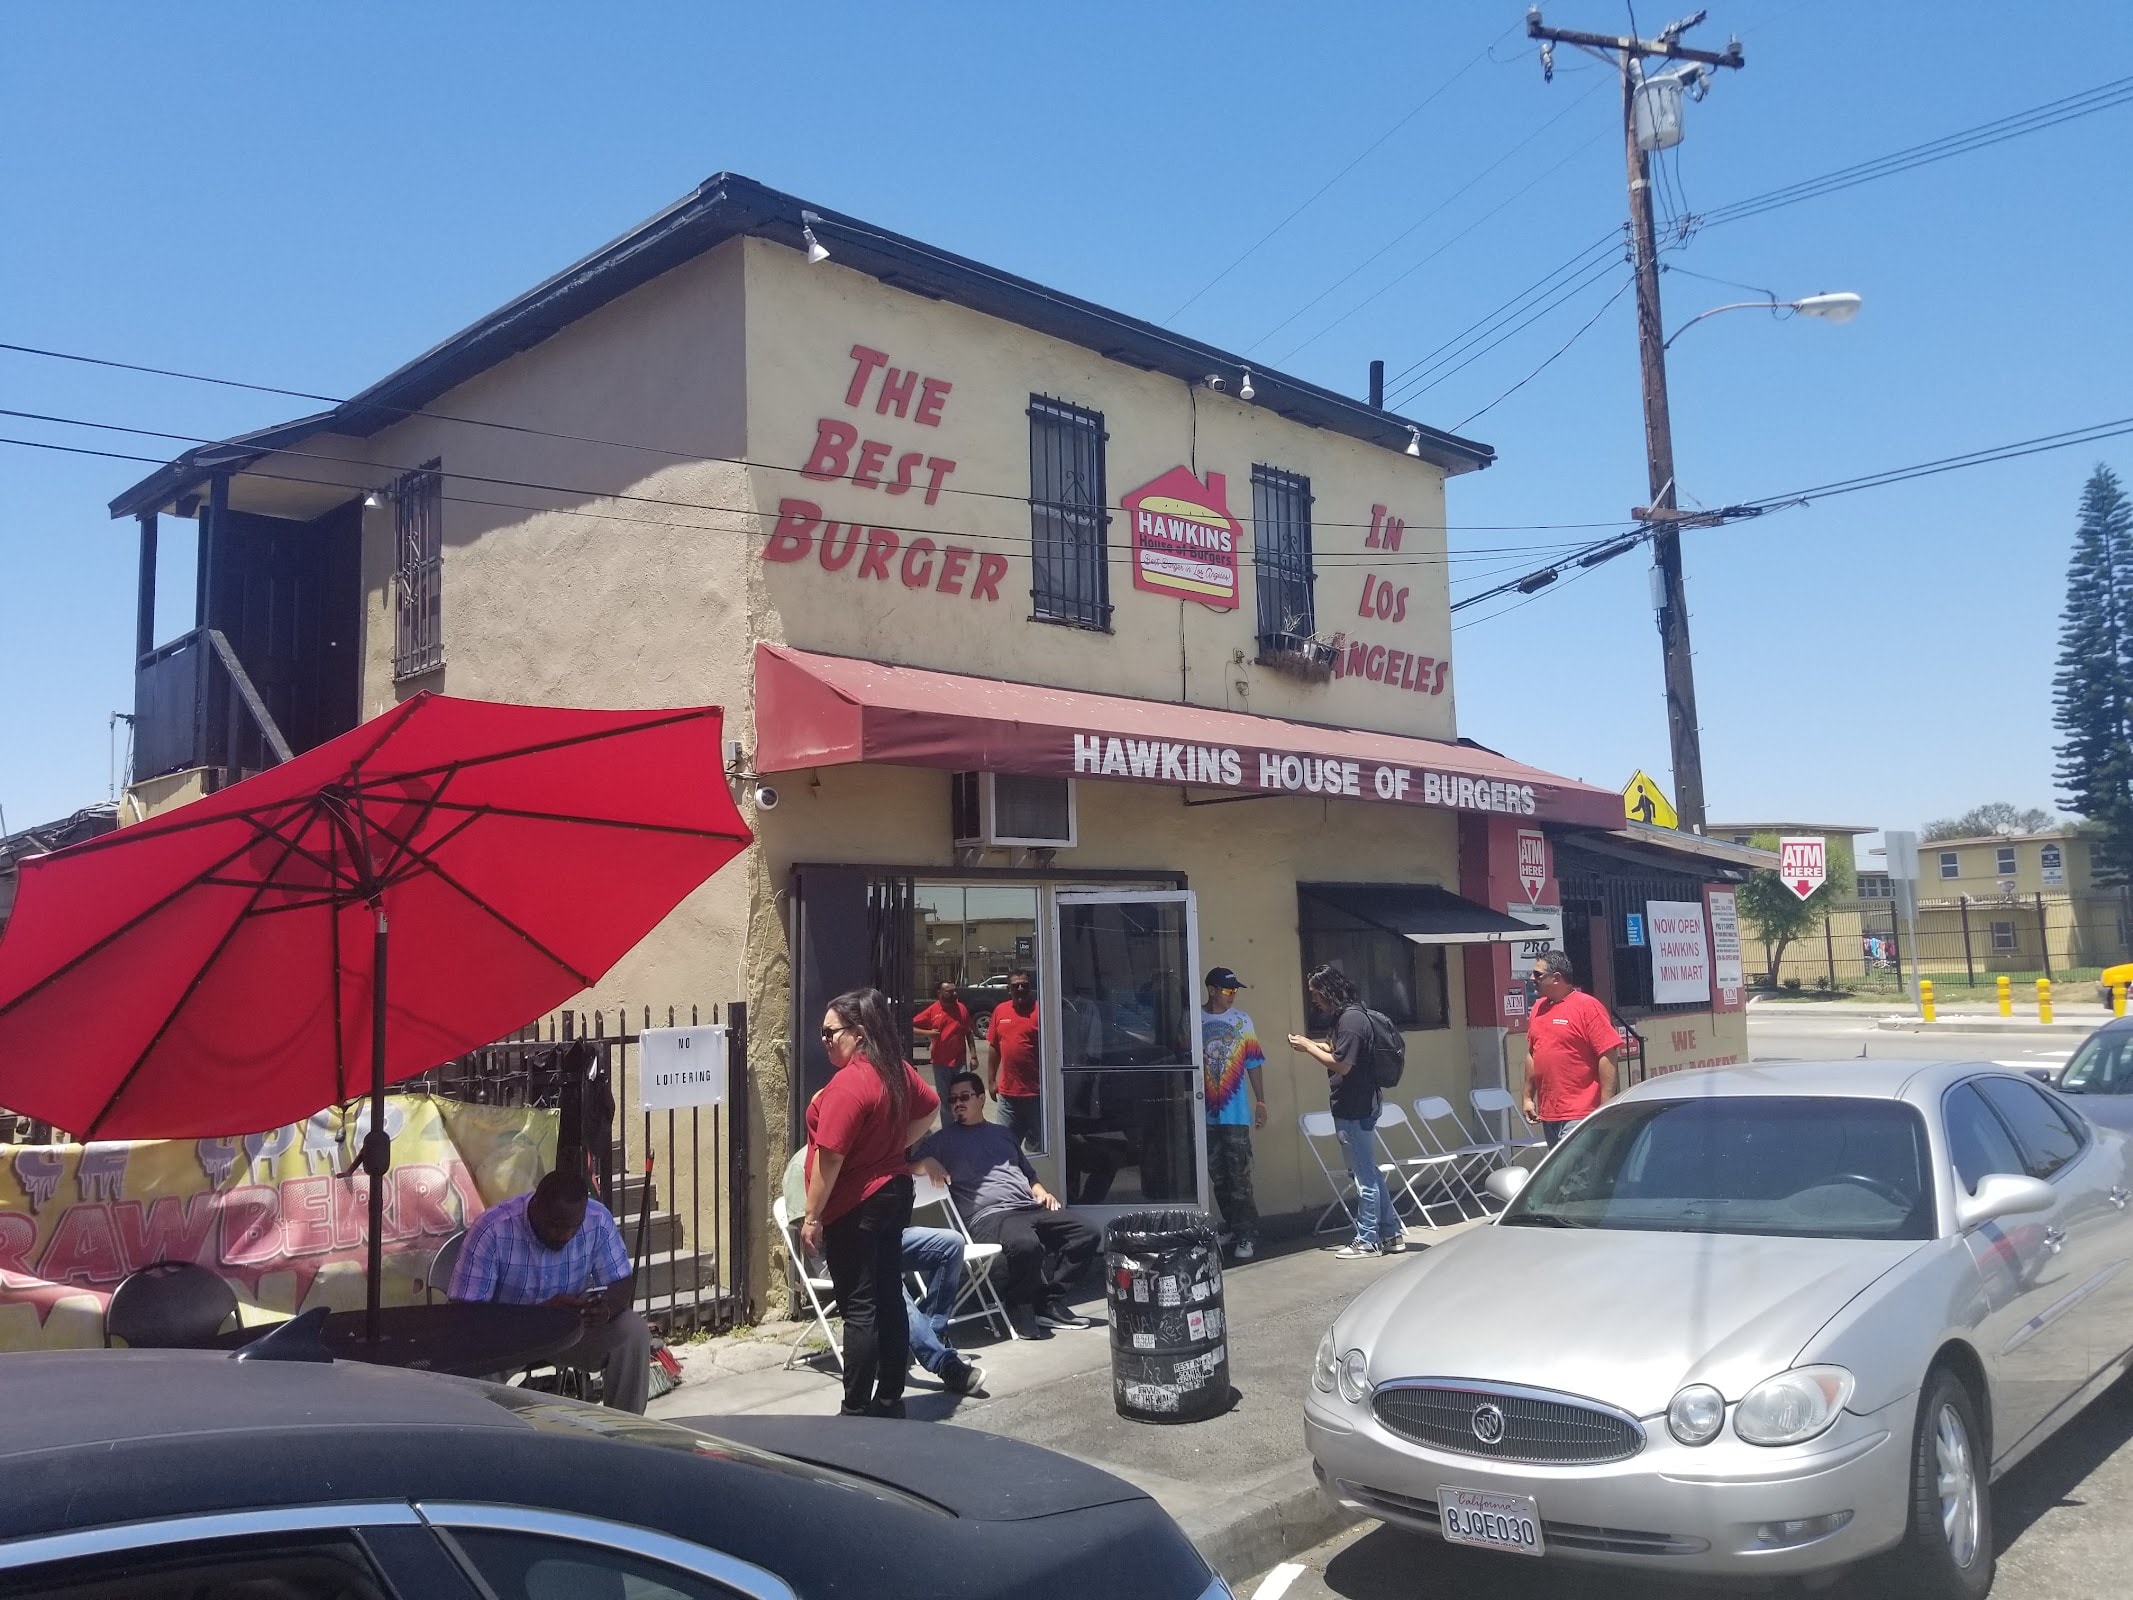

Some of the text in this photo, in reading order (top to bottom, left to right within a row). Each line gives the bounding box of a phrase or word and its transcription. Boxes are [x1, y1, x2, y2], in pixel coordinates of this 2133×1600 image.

[845, 344, 952, 427] THE
[801, 419, 956, 505] BEST
[1139, 511, 1231, 552] HAWKINS
[1365, 504, 1405, 551] IN
[761, 499, 1008, 601] BURGER
[1140, 533, 1173, 551] House
[1190, 546, 1232, 566] Burgers
[1359, 574, 1409, 622] LOS
[1074, 734, 1535, 815] HAWKINS HOUSE OF BURGERS
[1521, 839, 1543, 865] ATM
[1783, 845, 1822, 867] ATM
[1522, 865, 1543, 876] HERE
[1784, 867, 1822, 877] HERE
[1654, 919, 1675, 933] NOW
[1678, 919, 1700, 933] OPEN
[1523, 941, 1550, 952] PRO
[1661, 942, 1699, 957] HAWKINS
[1660, 965, 1703, 981] MINI MART
[1505, 996, 1523, 1008] ATM
[1724, 988, 1736, 999] ATM
[678, 1037, 690, 1049] NO
[1671, 1030, 1696, 1052] WE
[656, 1070, 711, 1086] LOITERING
[1458, 1493, 1518, 1512] California
[1448, 1508, 1535, 1545] 8JQE030
